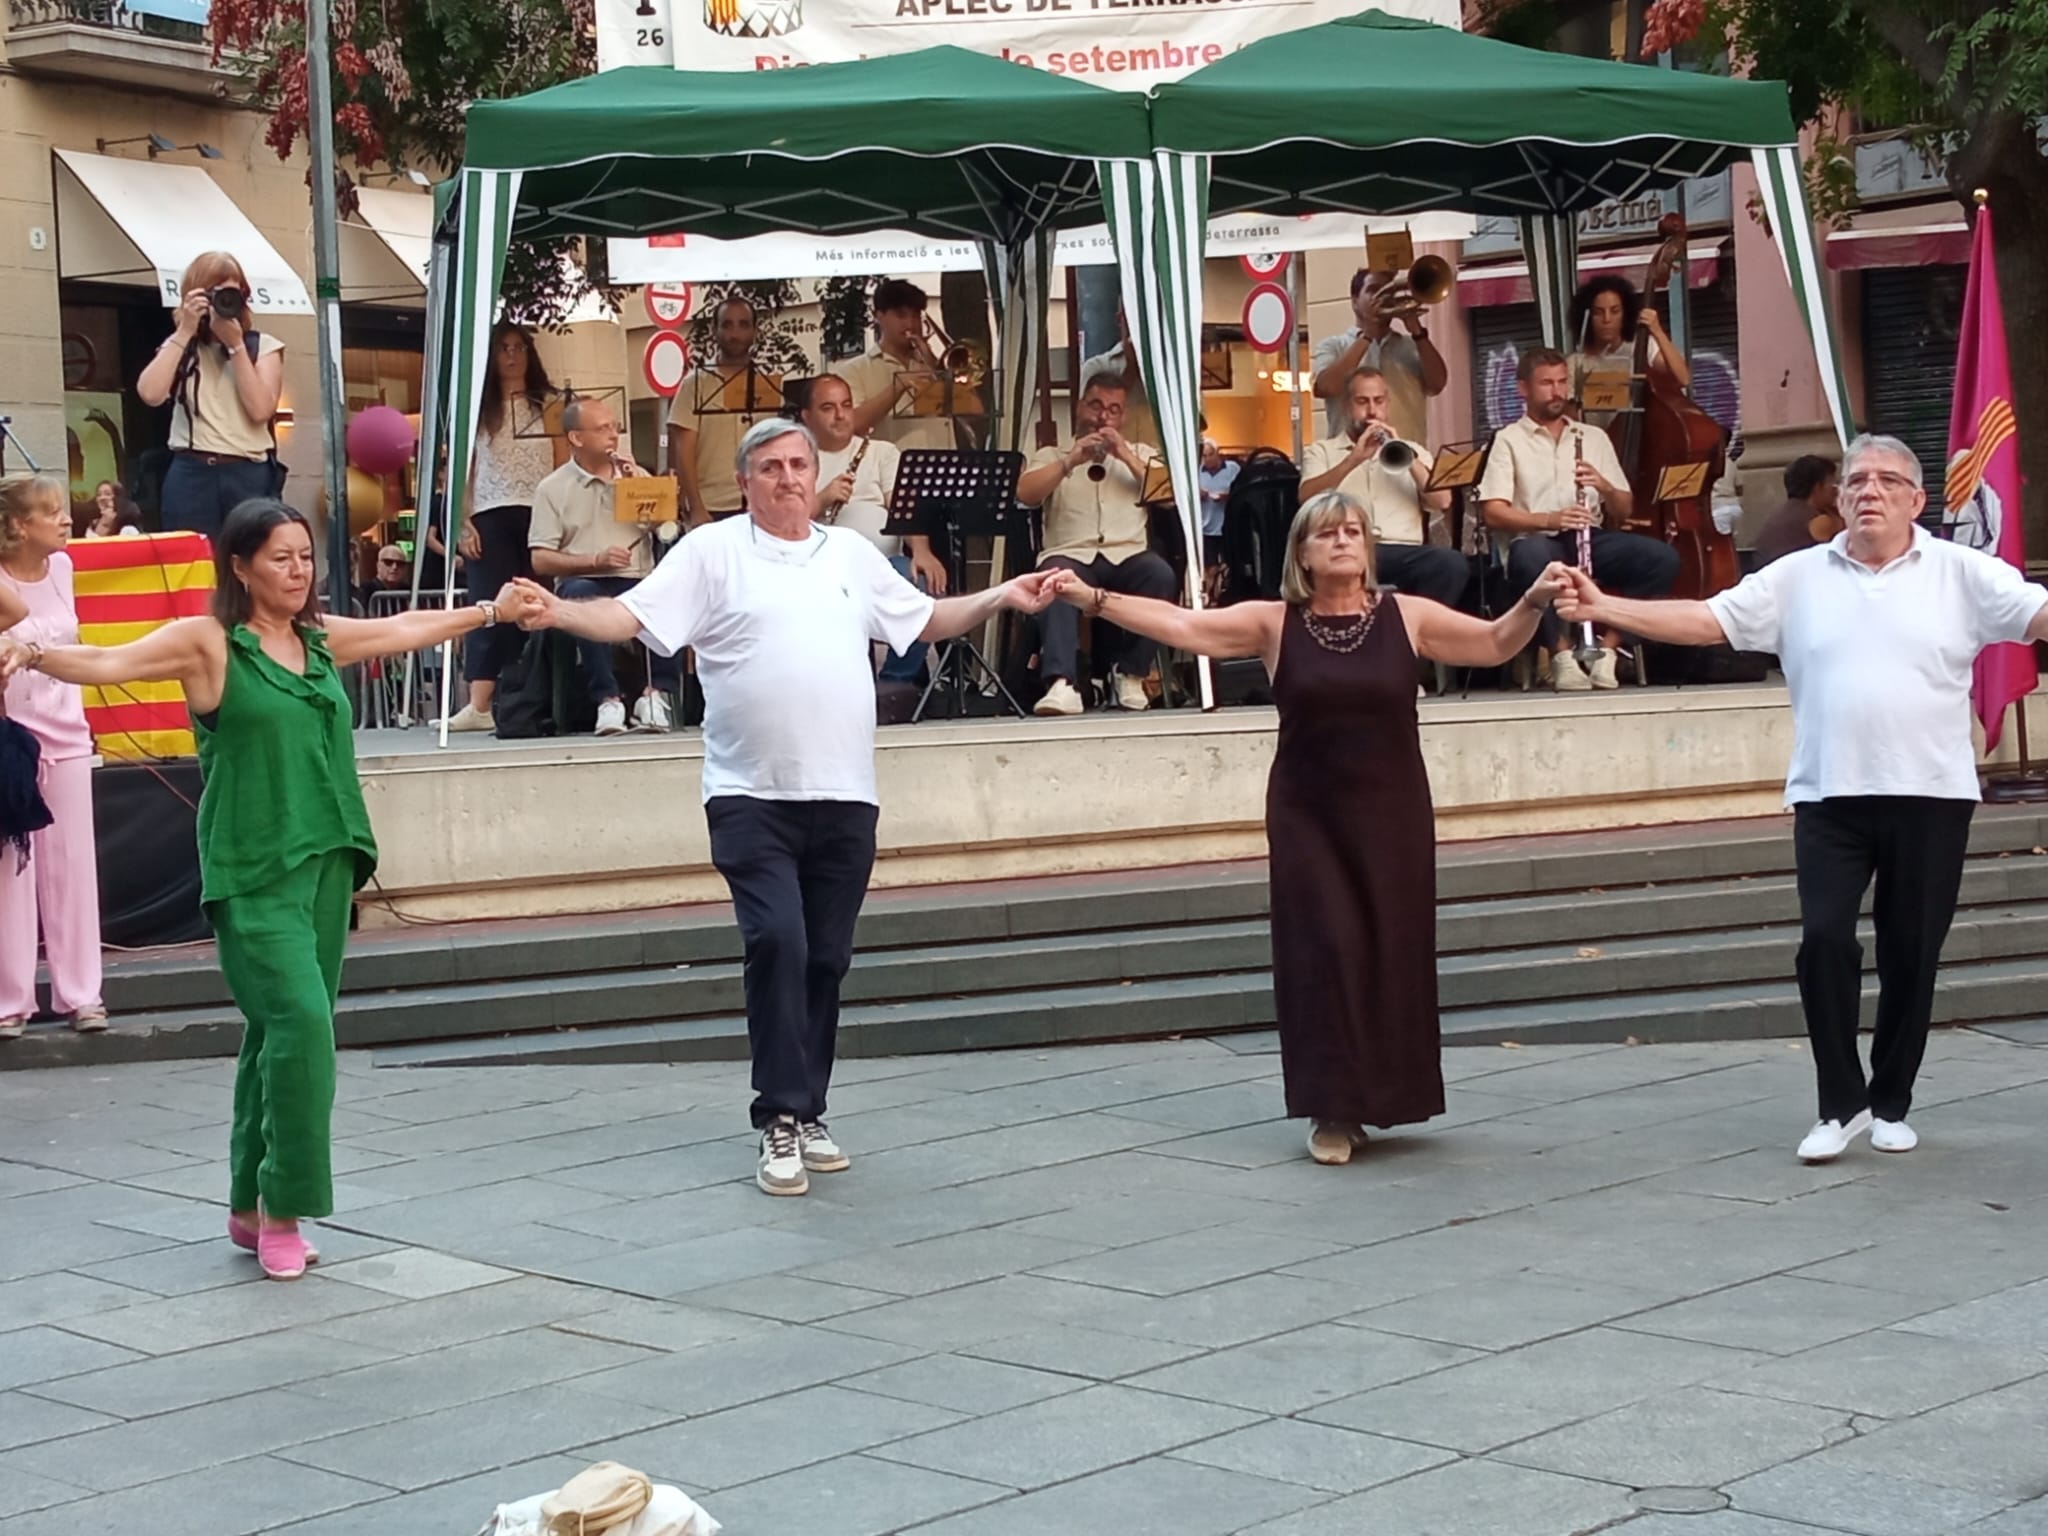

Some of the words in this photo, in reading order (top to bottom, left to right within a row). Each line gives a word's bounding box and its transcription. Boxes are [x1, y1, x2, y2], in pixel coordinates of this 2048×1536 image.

[895, 0, 1013, 16] APLEC
[637, 28, 664, 47] 26
[1047, 41, 1222, 75] setembre
[816, 248, 844, 261] Més
[851, 245, 928, 260] informació
[934, 249, 943, 257] a
[950, 246, 970, 256] les
[1091, 237, 1114, 248] soc
[1205, 226, 1281, 241] deterrassa
